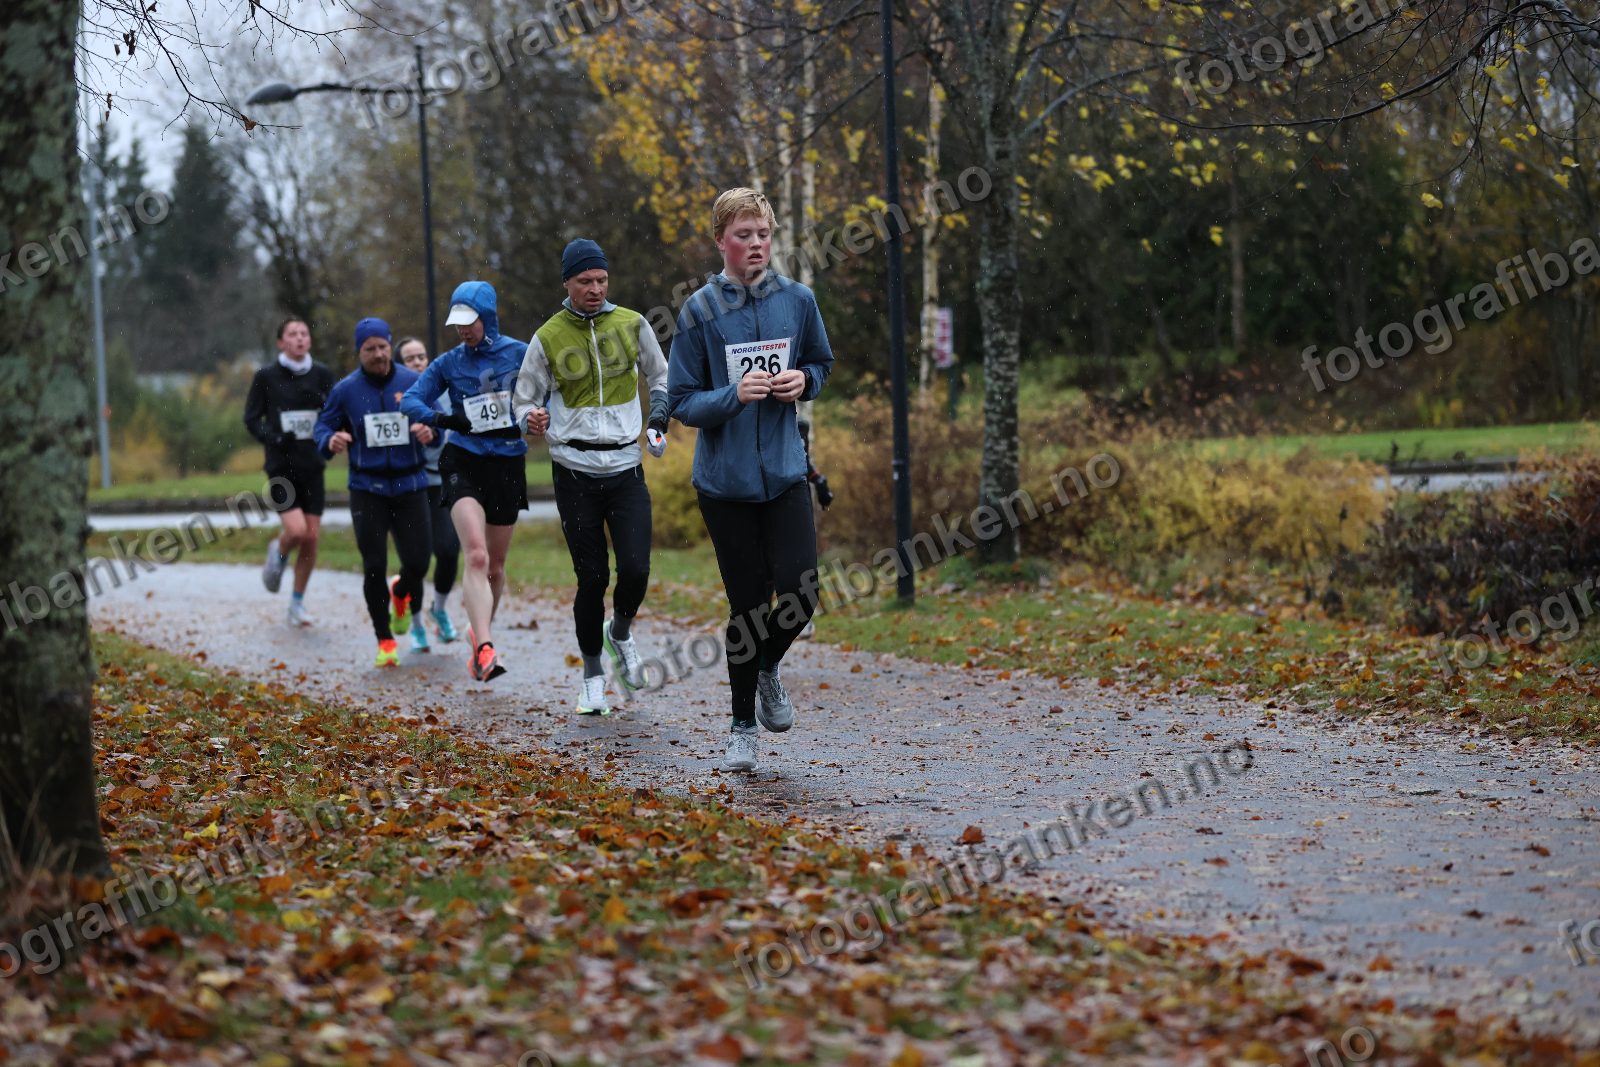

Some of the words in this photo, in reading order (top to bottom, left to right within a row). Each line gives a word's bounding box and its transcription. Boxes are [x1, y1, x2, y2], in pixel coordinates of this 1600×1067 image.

[732, 342, 787, 354] NORGESTESTEN
[740, 353, 782, 379] 236
[481, 402, 499, 421] 49
[374, 421, 400, 438] 769
